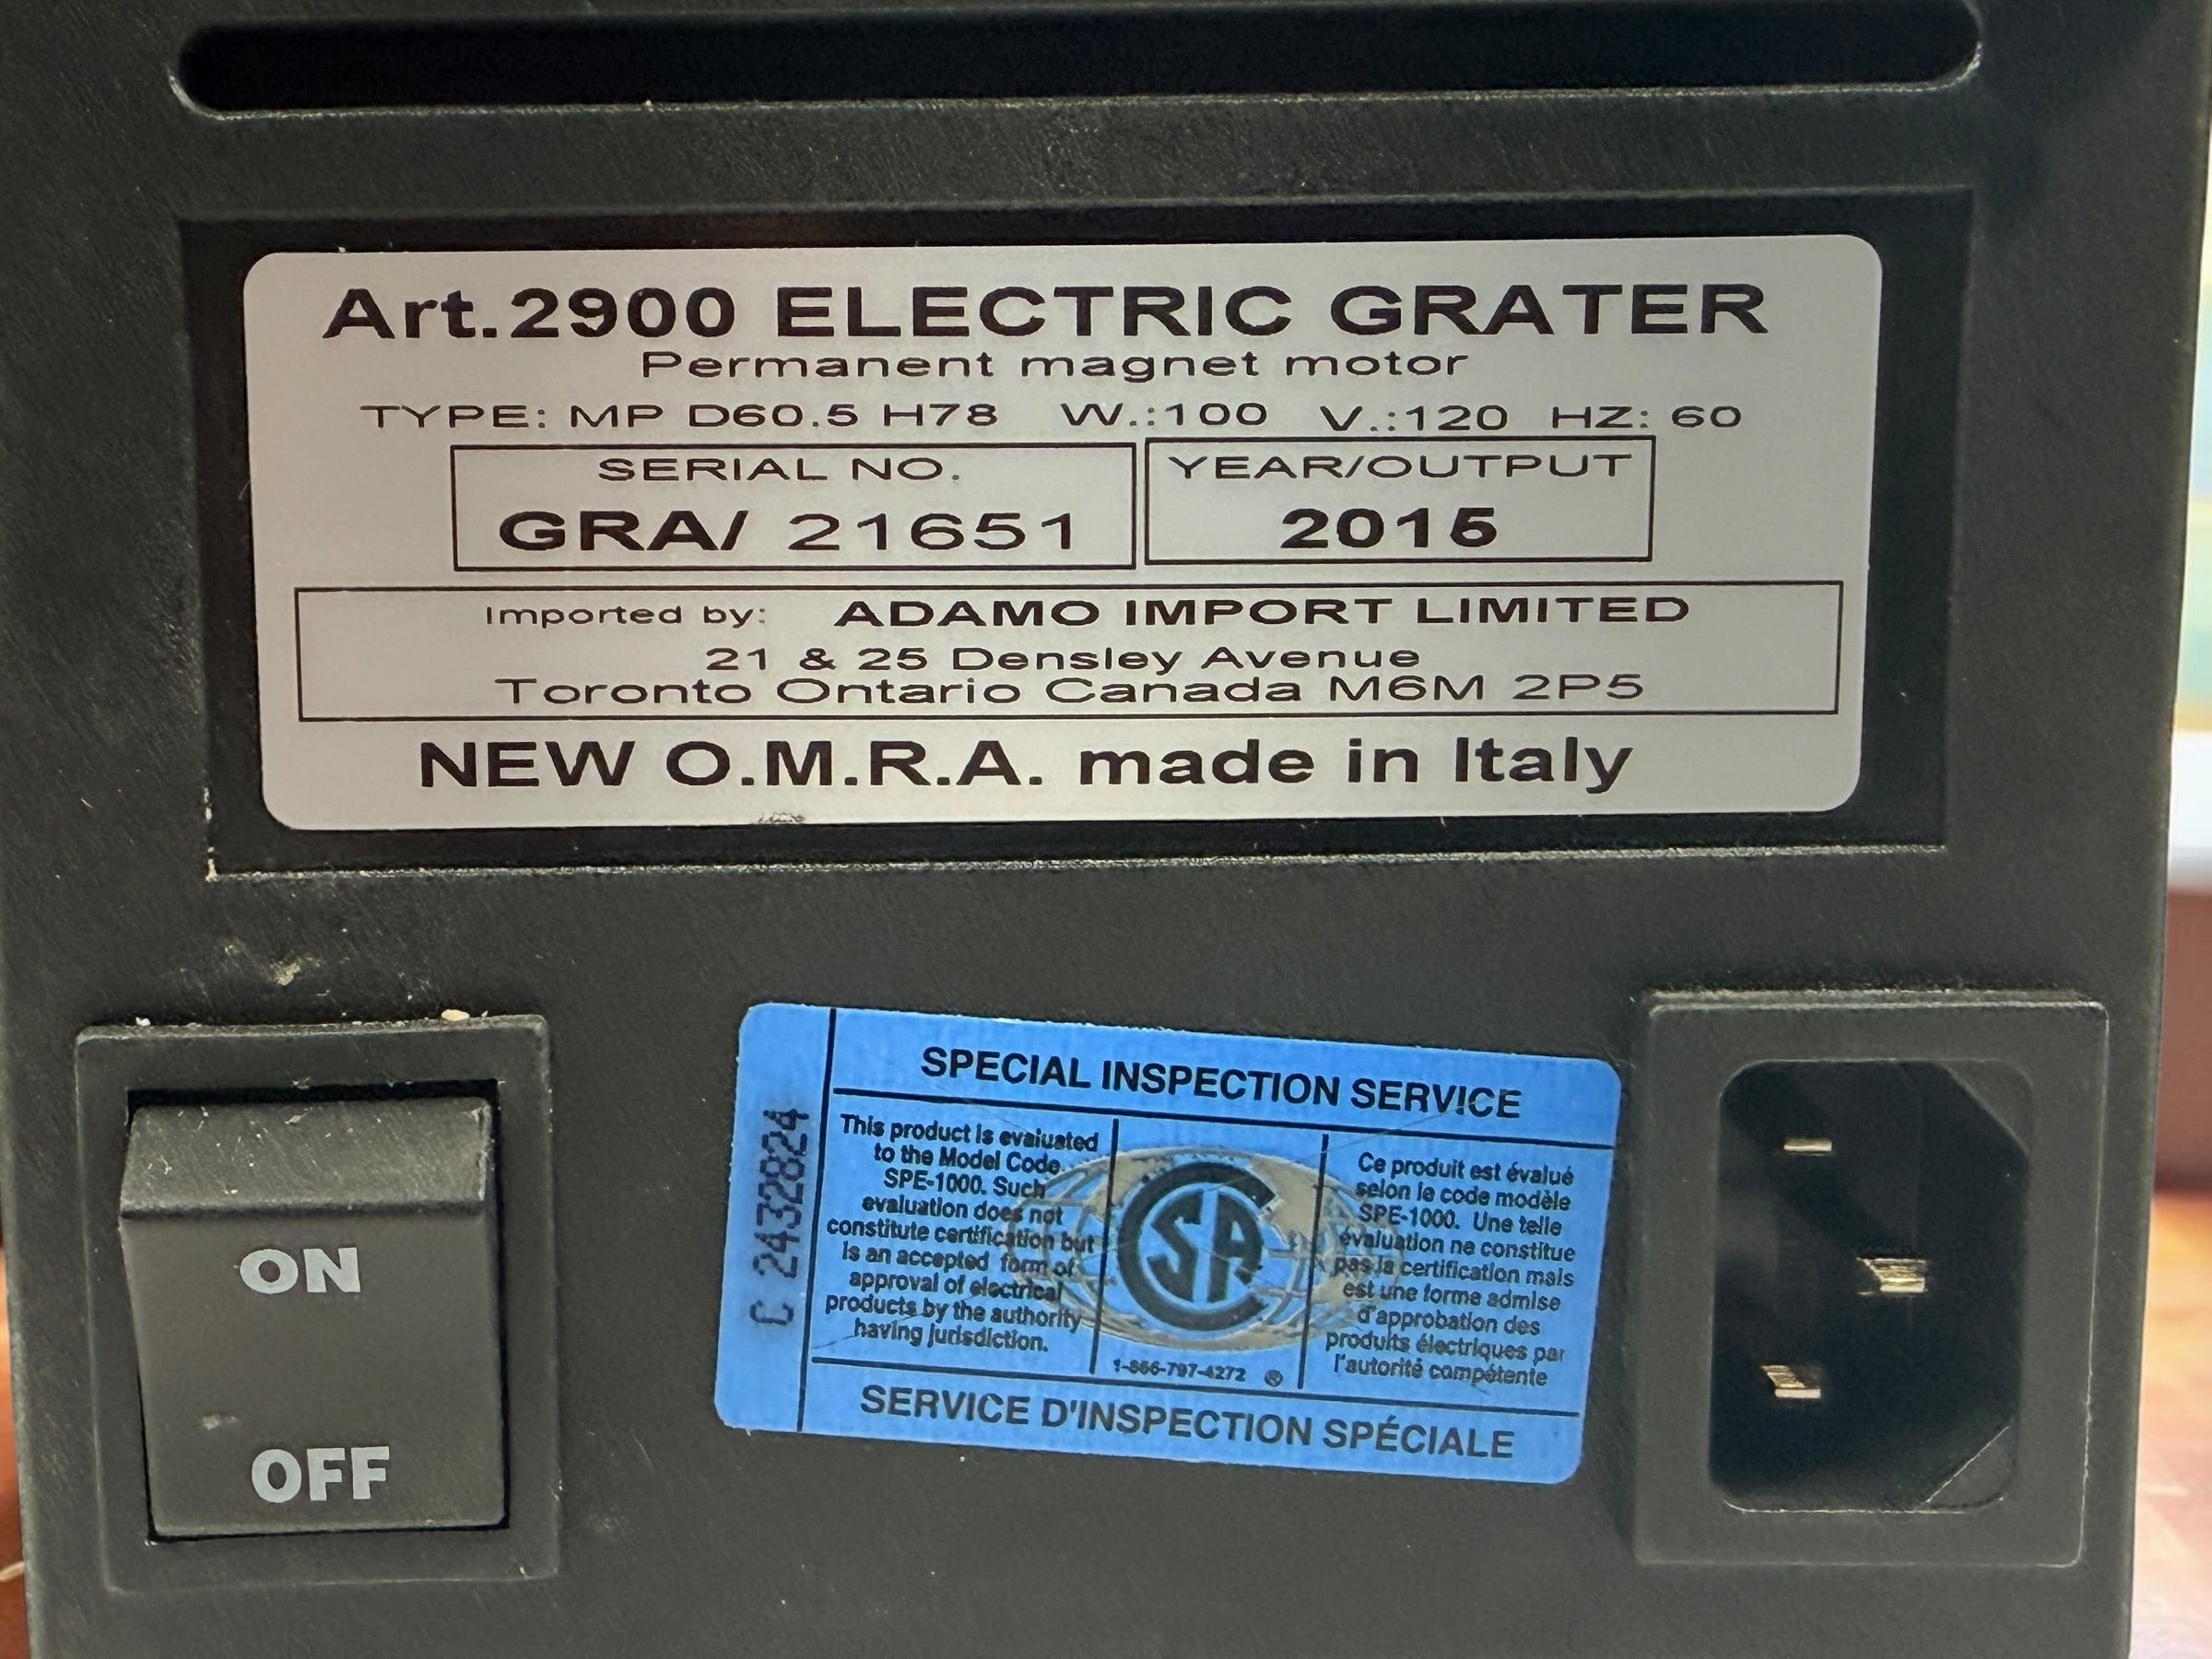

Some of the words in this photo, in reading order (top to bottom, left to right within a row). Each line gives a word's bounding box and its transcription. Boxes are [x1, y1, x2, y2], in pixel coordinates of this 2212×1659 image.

[323, 288, 735, 339] Art.2900
[777, 286, 1291, 336] ELECTRIC
[1331, 284, 1768, 335] GRATER
[643, 351, 994, 378] Permanent
[1022, 351, 1259, 382] magnet
[1287, 351, 1468, 376] motor
[360, 406, 545, 428] TYPE:
[571, 405, 663, 428] MP
[689, 404, 858, 427] D60.5
[884, 404, 997, 427] H78
[1061, 403, 1266, 426] W.:100
[1320, 406, 1507, 431] V.:120
[1552, 406, 1648, 429] HZ:
[1672, 406, 1741, 428] 60
[599, 458, 828, 481] SERIAL
[853, 458, 959, 480] NO.
[1169, 454, 1631, 478] YEAR/OUTPUT
[500, 511, 748, 550] GRA/
[788, 512, 1070, 550] 21651
[487, 606, 681, 629] Imported
[704, 606, 765, 629] by:
[834, 601, 1100, 627] ADAMO
[1126, 598, 1392, 625] IMPORT
[1418, 597, 1688, 623] LIMITED
[707, 648, 766, 670] 21
[799, 648, 836, 670] &
[858, 648, 927, 670] 25
[953, 647, 1182, 676] Densley
[1201, 647, 1418, 669] Avenue
[495, 678, 751, 704] Toronto
[777, 677, 1020, 703] Ontario
[1046, 677, 1301, 703] Canada
[1330, 675, 1483, 700] M6M
[1512, 674, 1642, 700] 2P5
[421, 741, 635, 787] NEW
[666, 740, 1042, 785] O.M.R.A.
[1080, 739, 1314, 784] made
[1348, 738, 1418, 782] in
[1455, 736, 1633, 794] Italy
[922, 1046, 1091, 1089] SPECIAL
[1101, 1059, 1340, 1107] INSPECTION
[1351, 1078, 1523, 1119] SERVICE
[841, 1113, 885, 1136] This
[890, 1120, 971, 1143] product
[975, 1123, 994, 1146] is
[998, 1128, 1099, 1152] evaluated
[875, 1142, 895, 1163] to
[900, 1145, 934, 1165] the
[939, 1147, 1001, 1171] Model
[1006, 1152, 1061, 1174] Code
[1359, 1151, 1386, 1173] Ce
[1391, 1157, 1465, 1179] produit
[1470, 1162, 1501, 1181] est
[1506, 1161, 1574, 1186] évalué
[752, 1108, 809, 1278] 2432824
[884, 1167, 987, 1194] SPE-1000.
[993, 1178, 1046, 1198] Such
[1356, 1179, 1411, 1198] selon
[1418, 1181, 1435, 1199] le
[1441, 1185, 1490, 1205] code
[1495, 1190, 1571, 1211] modèle
[862, 1194, 967, 1219] evaluation
[973, 1201, 1022, 1222] does
[1029, 1207, 1064, 1225] not
[1359, 1203, 1460, 1230] SPE-1000.
[1473, 1211, 1512, 1232] Une
[1519, 1215, 1563, 1236] telle
[826, 1217, 930, 1241] constitute
[934, 1225, 1054, 1250] certification
[1060, 1230, 1095, 1253] but
[1339, 1225, 1444, 1253] évaluation
[1450, 1240, 1476, 1256] ne
[1480, 1241, 1576, 1262] constitue
[239, 1247, 361, 1294] ON
[842, 1241, 860, 1262] is
[865, 1249, 892, 1265] an
[896, 1249, 989, 1273] accepted
[1000, 1253, 1048, 1276] form
[1053, 1259, 1077, 1277] of
[1335, 1256, 1372, 1276] pas
[1399, 1260, 1520, 1283] certification
[1525, 1267, 1574, 1287] mais
[849, 1271, 939, 1293] approval
[944, 1275, 966, 1295] of
[970, 1276, 1064, 1302] electrical
[1343, 1281, 1374, 1298] est
[1380, 1287, 1418, 1301] une
[1423, 1283, 1482, 1306] forme
[1487, 1289, 1561, 1311] admise
[749, 1300, 794, 1326] C
[825, 1294, 917, 1316] products
[923, 1298, 949, 1324] by
[953, 1301, 986, 1322] the
[990, 1305, 1082, 1334] authority
[1358, 1305, 1498, 1333] d'approbation
[1503, 1315, 1541, 1335] des
[854, 1318, 923, 1347] having
[927, 1324, 1049, 1352] jurisdiction.
[1325, 1331, 1409, 1353] produits
[1417, 1333, 1527, 1363] électriques
[1534, 1347, 1564, 1365] par
[1335, 1354, 1423, 1378] l'autorité
[1430, 1363, 1548, 1387] compétente
[861, 1384, 1031, 1424] SERVICE
[1042, 1398, 1312, 1445] D'INSPECTION
[1323, 1415, 1515, 1459] SPÉCIALE
[250, 1445, 390, 1503] OFF
